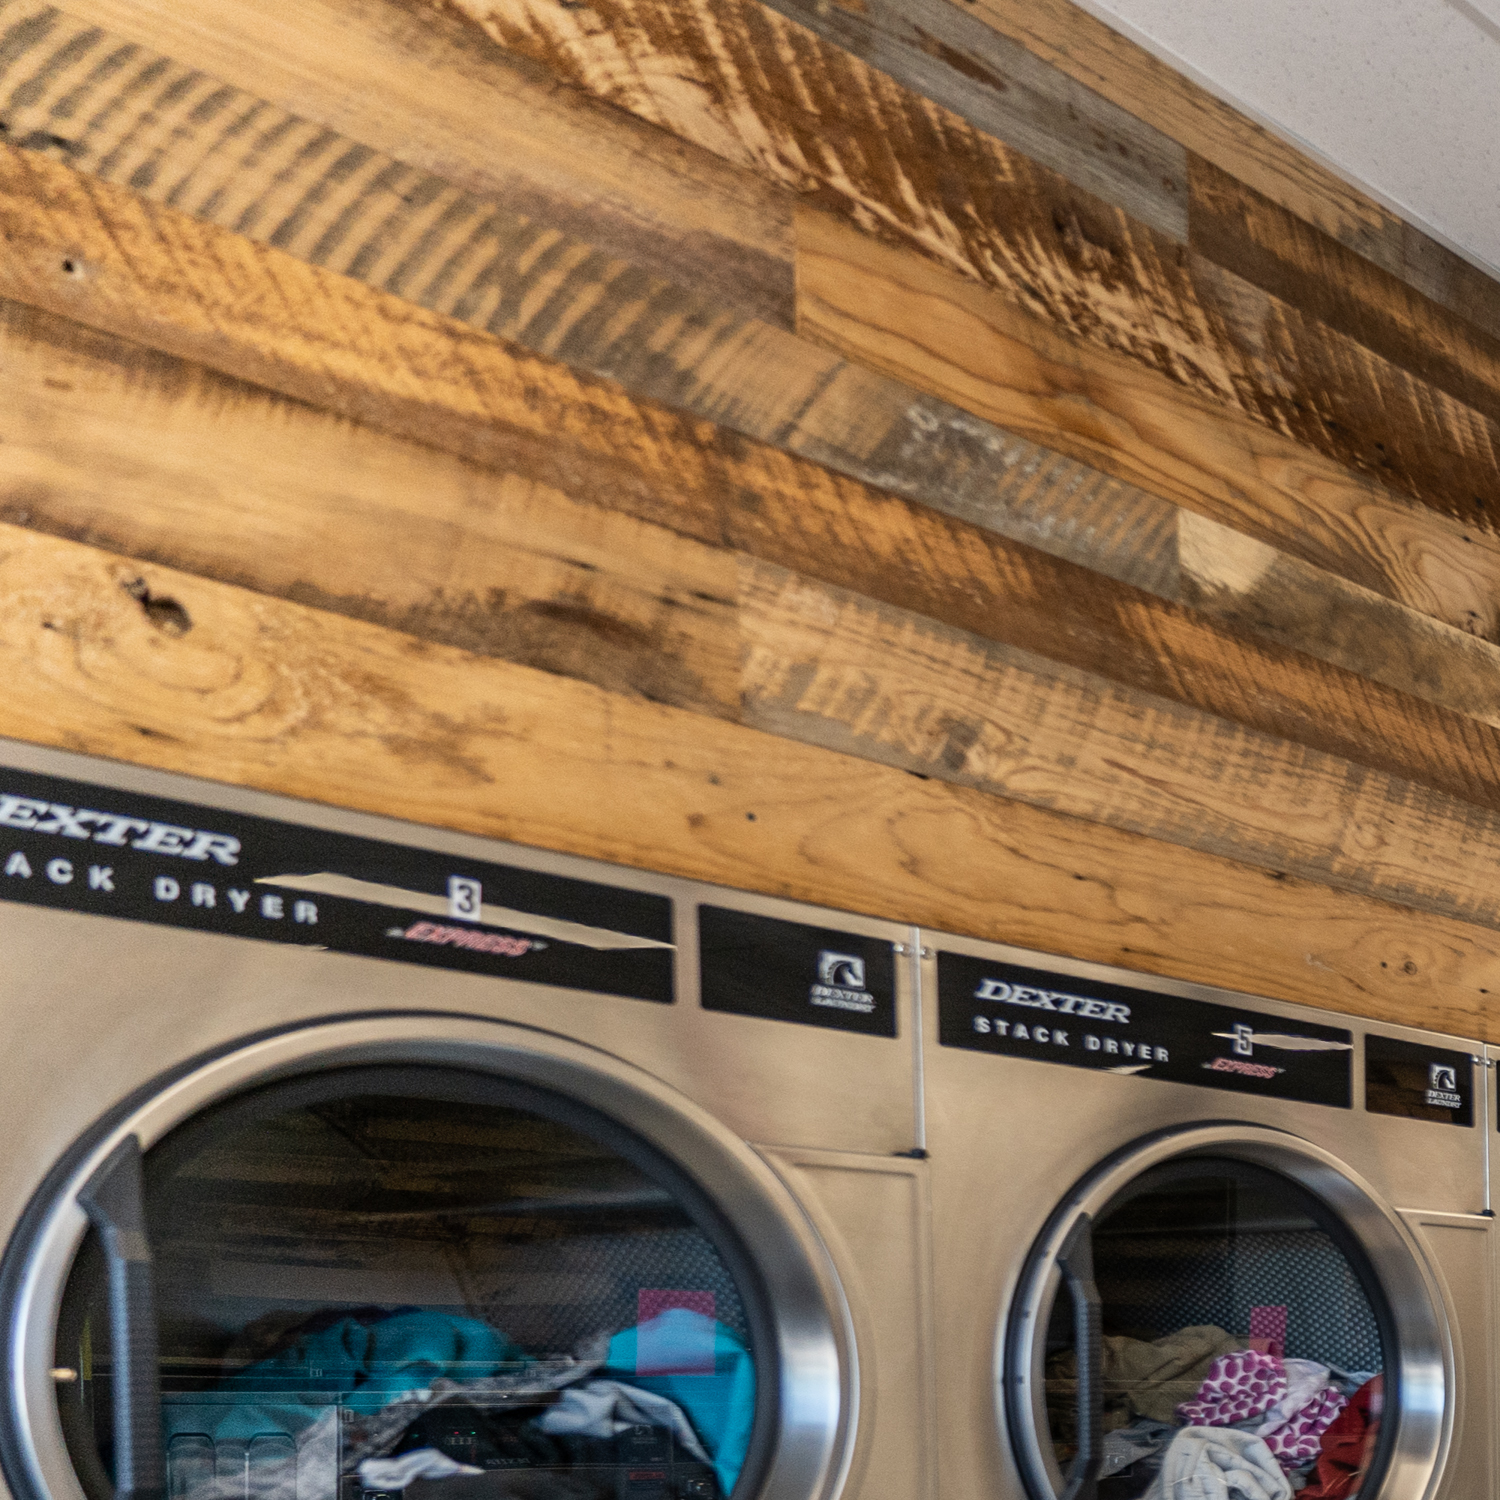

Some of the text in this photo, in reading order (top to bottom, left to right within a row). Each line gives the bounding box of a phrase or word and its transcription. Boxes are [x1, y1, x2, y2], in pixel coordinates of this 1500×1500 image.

[154, 875, 319, 925] DRYER
[974, 977, 1132, 1024] DEXTER
[972, 1014, 1169, 1063] STACK DRYER
[1211, 1056, 1278, 1079] EXPRESS
